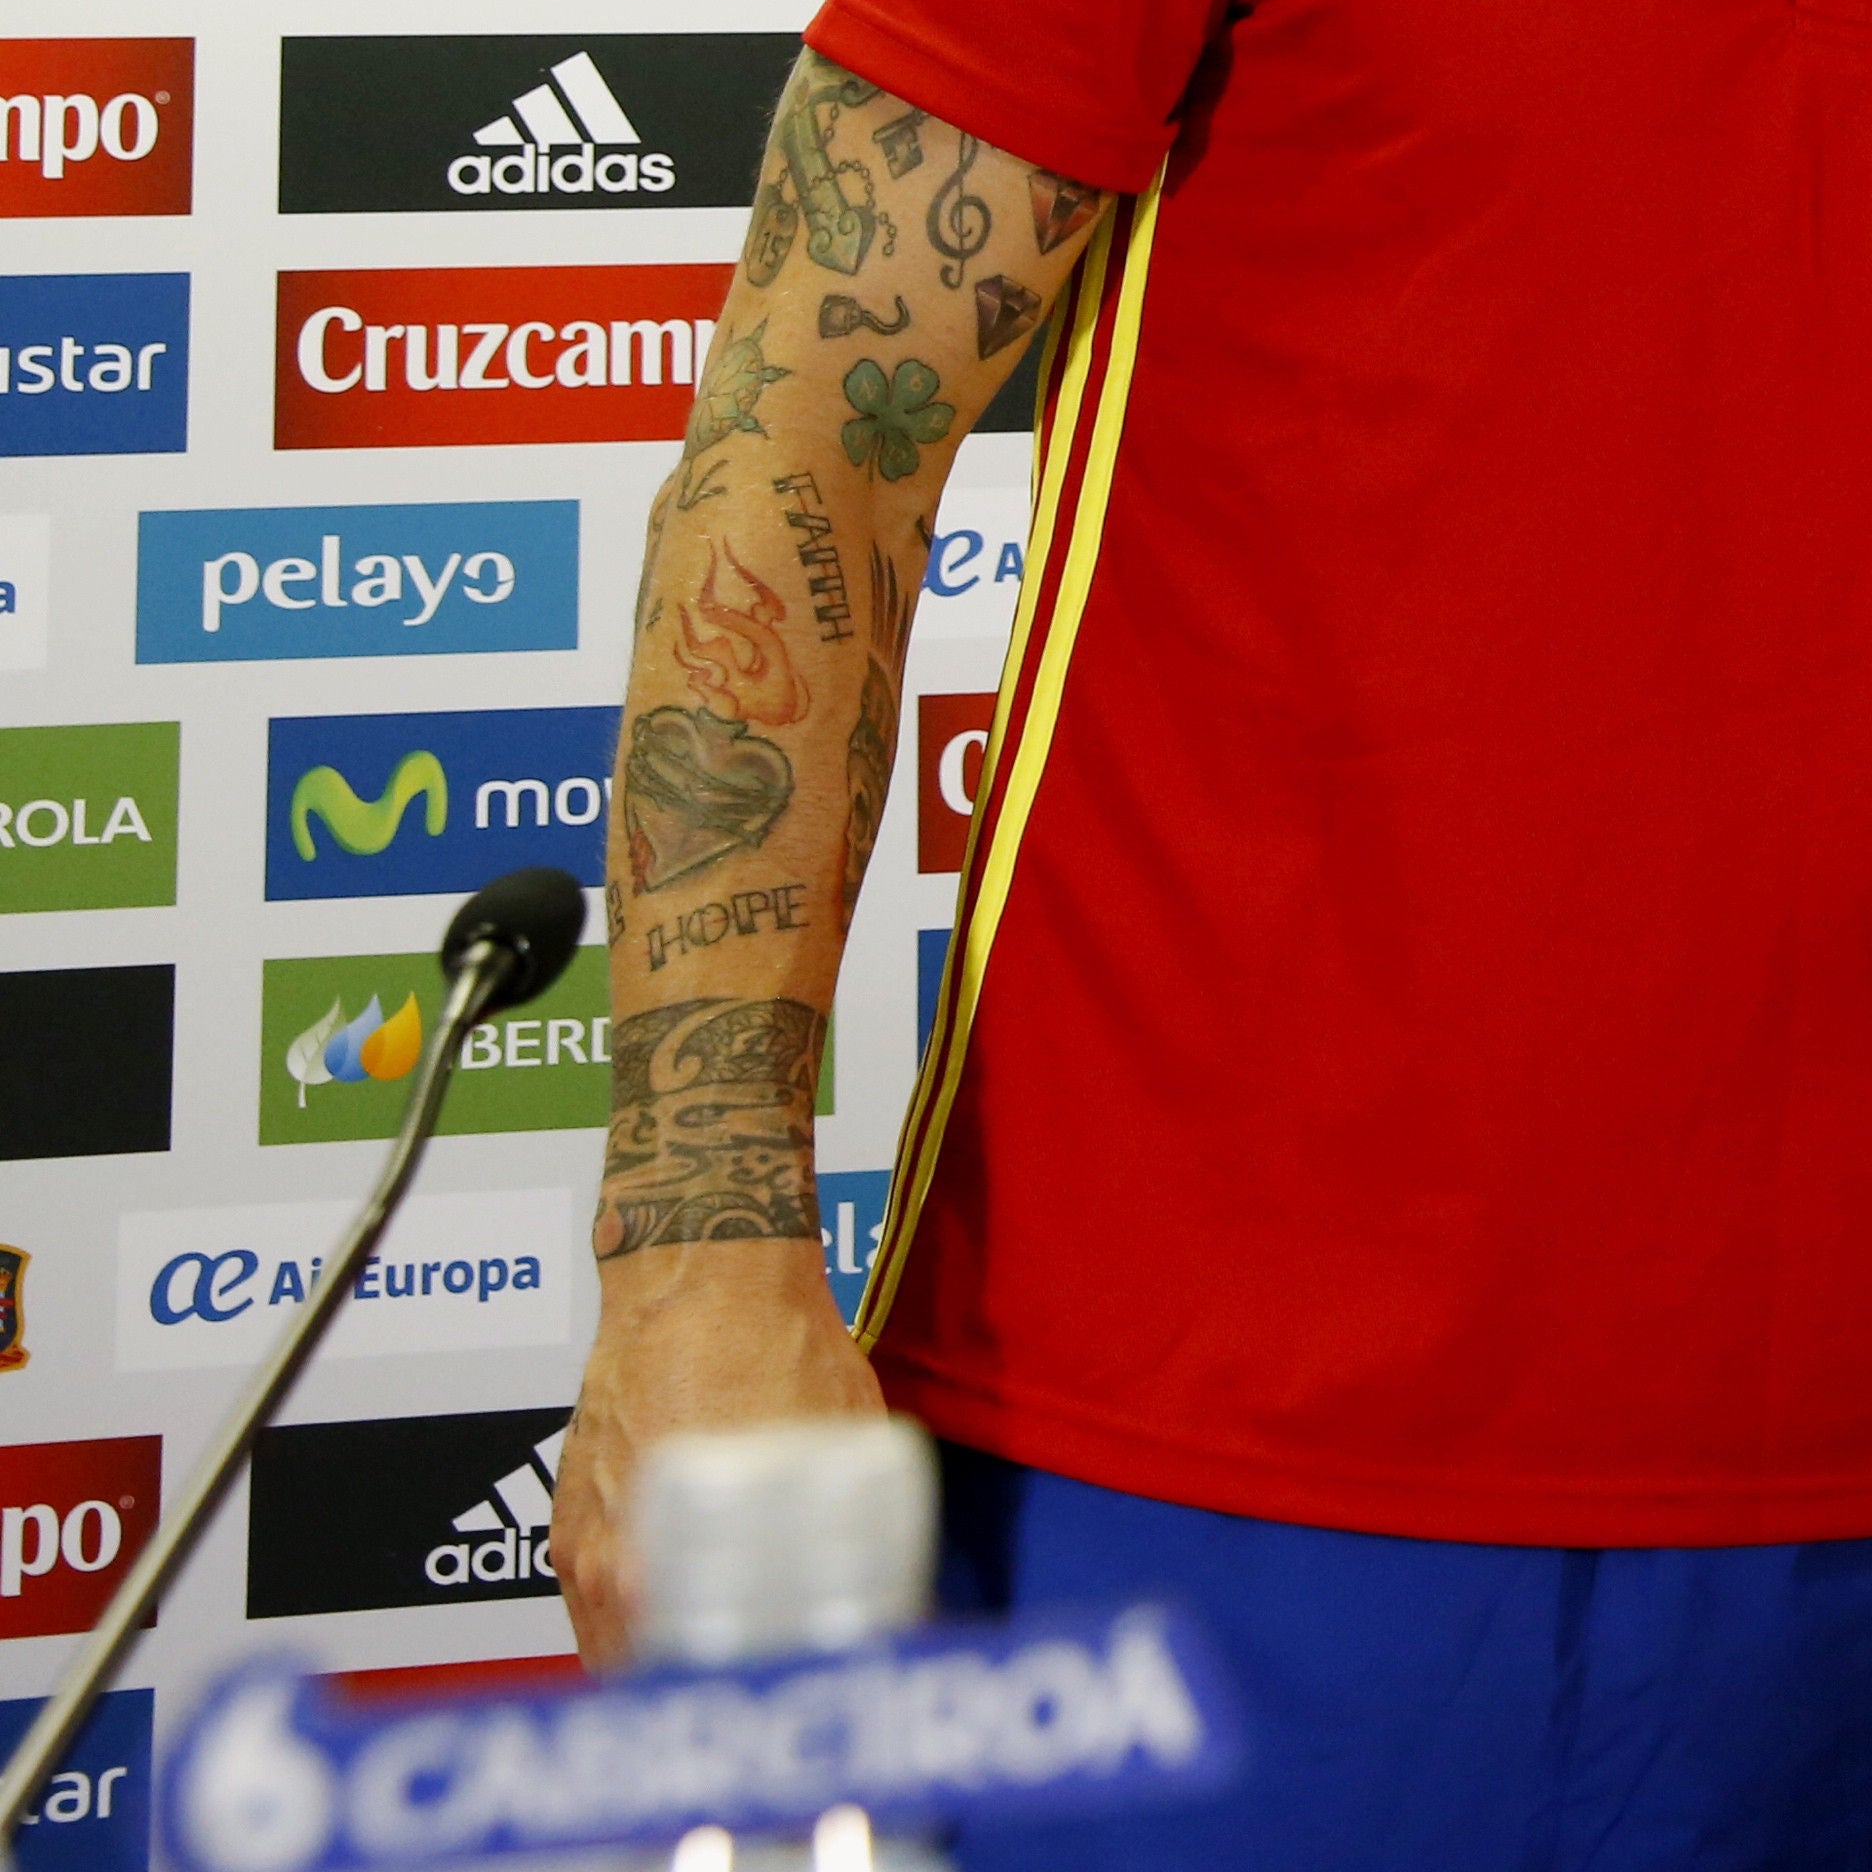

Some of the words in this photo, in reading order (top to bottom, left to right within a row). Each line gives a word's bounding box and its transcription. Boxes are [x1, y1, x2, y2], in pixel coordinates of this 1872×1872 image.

[448, 144, 677, 195] adidas
[203, 535, 515, 634] pelayo
[269, 1252, 541, 1306] AiEuropa
